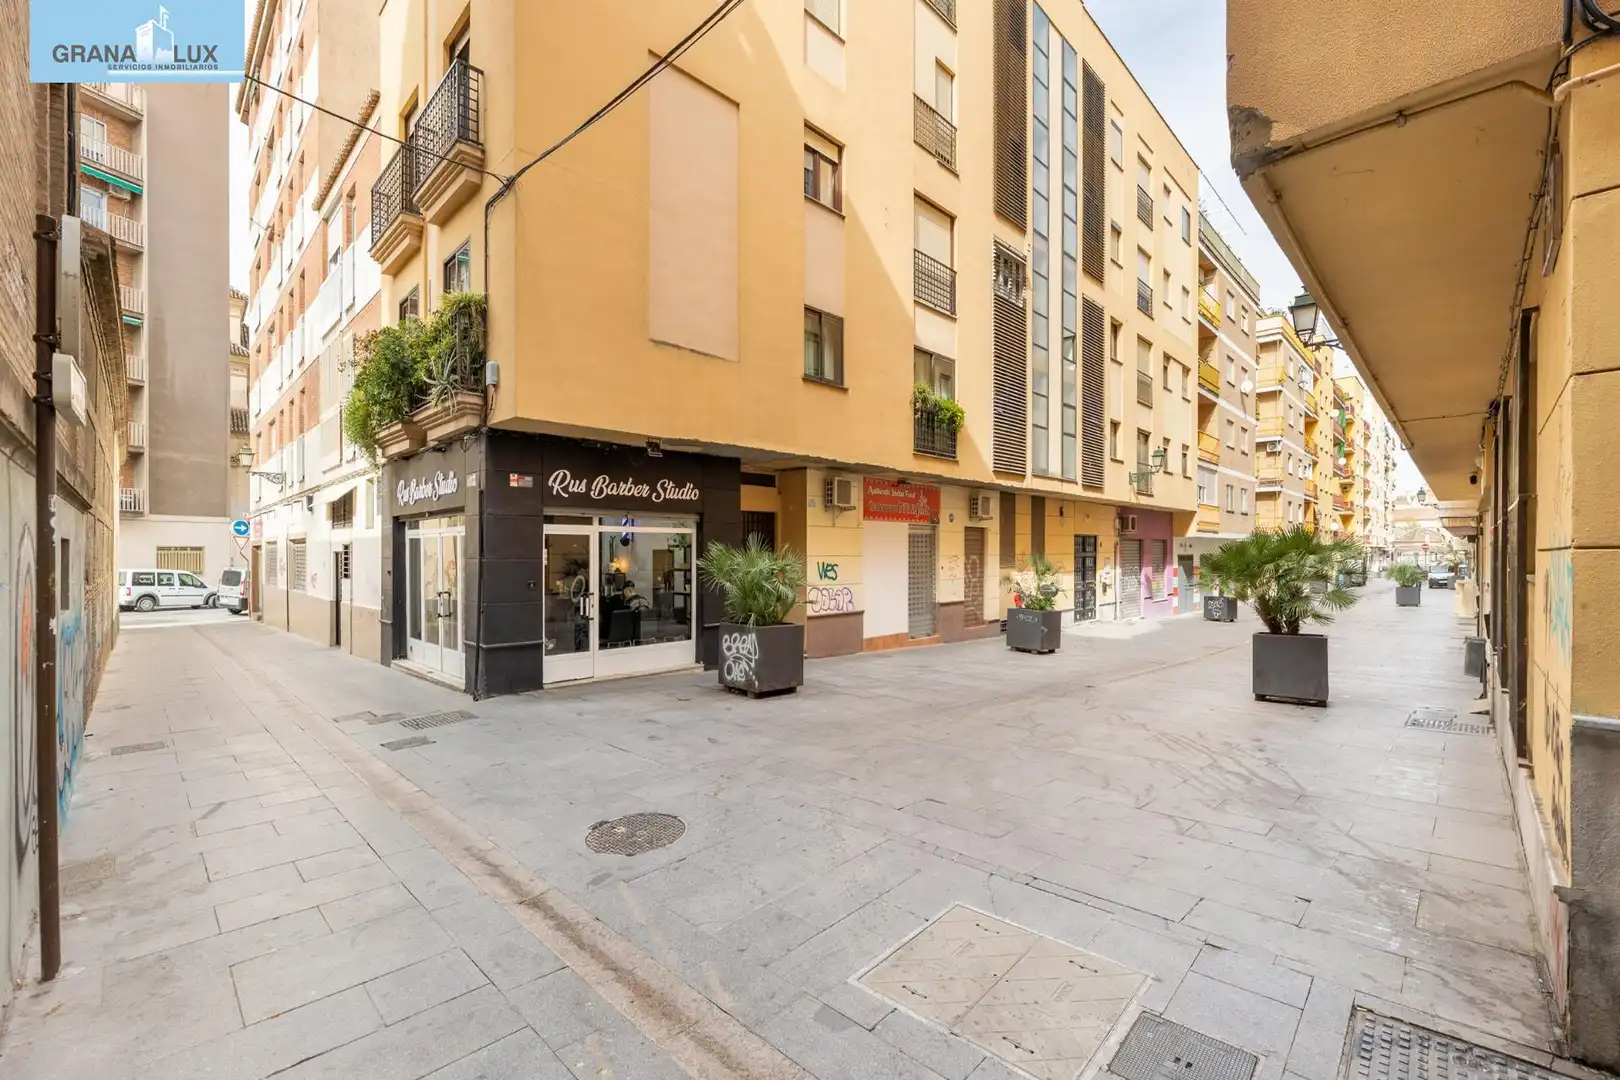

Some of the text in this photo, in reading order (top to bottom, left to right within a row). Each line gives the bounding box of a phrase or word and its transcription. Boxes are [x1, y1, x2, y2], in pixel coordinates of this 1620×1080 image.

[432, 470, 458, 501] Studio
[548, 469, 588, 498] Rus
[590, 474, 651, 499] Barber
[651, 478, 700, 503] Studio
